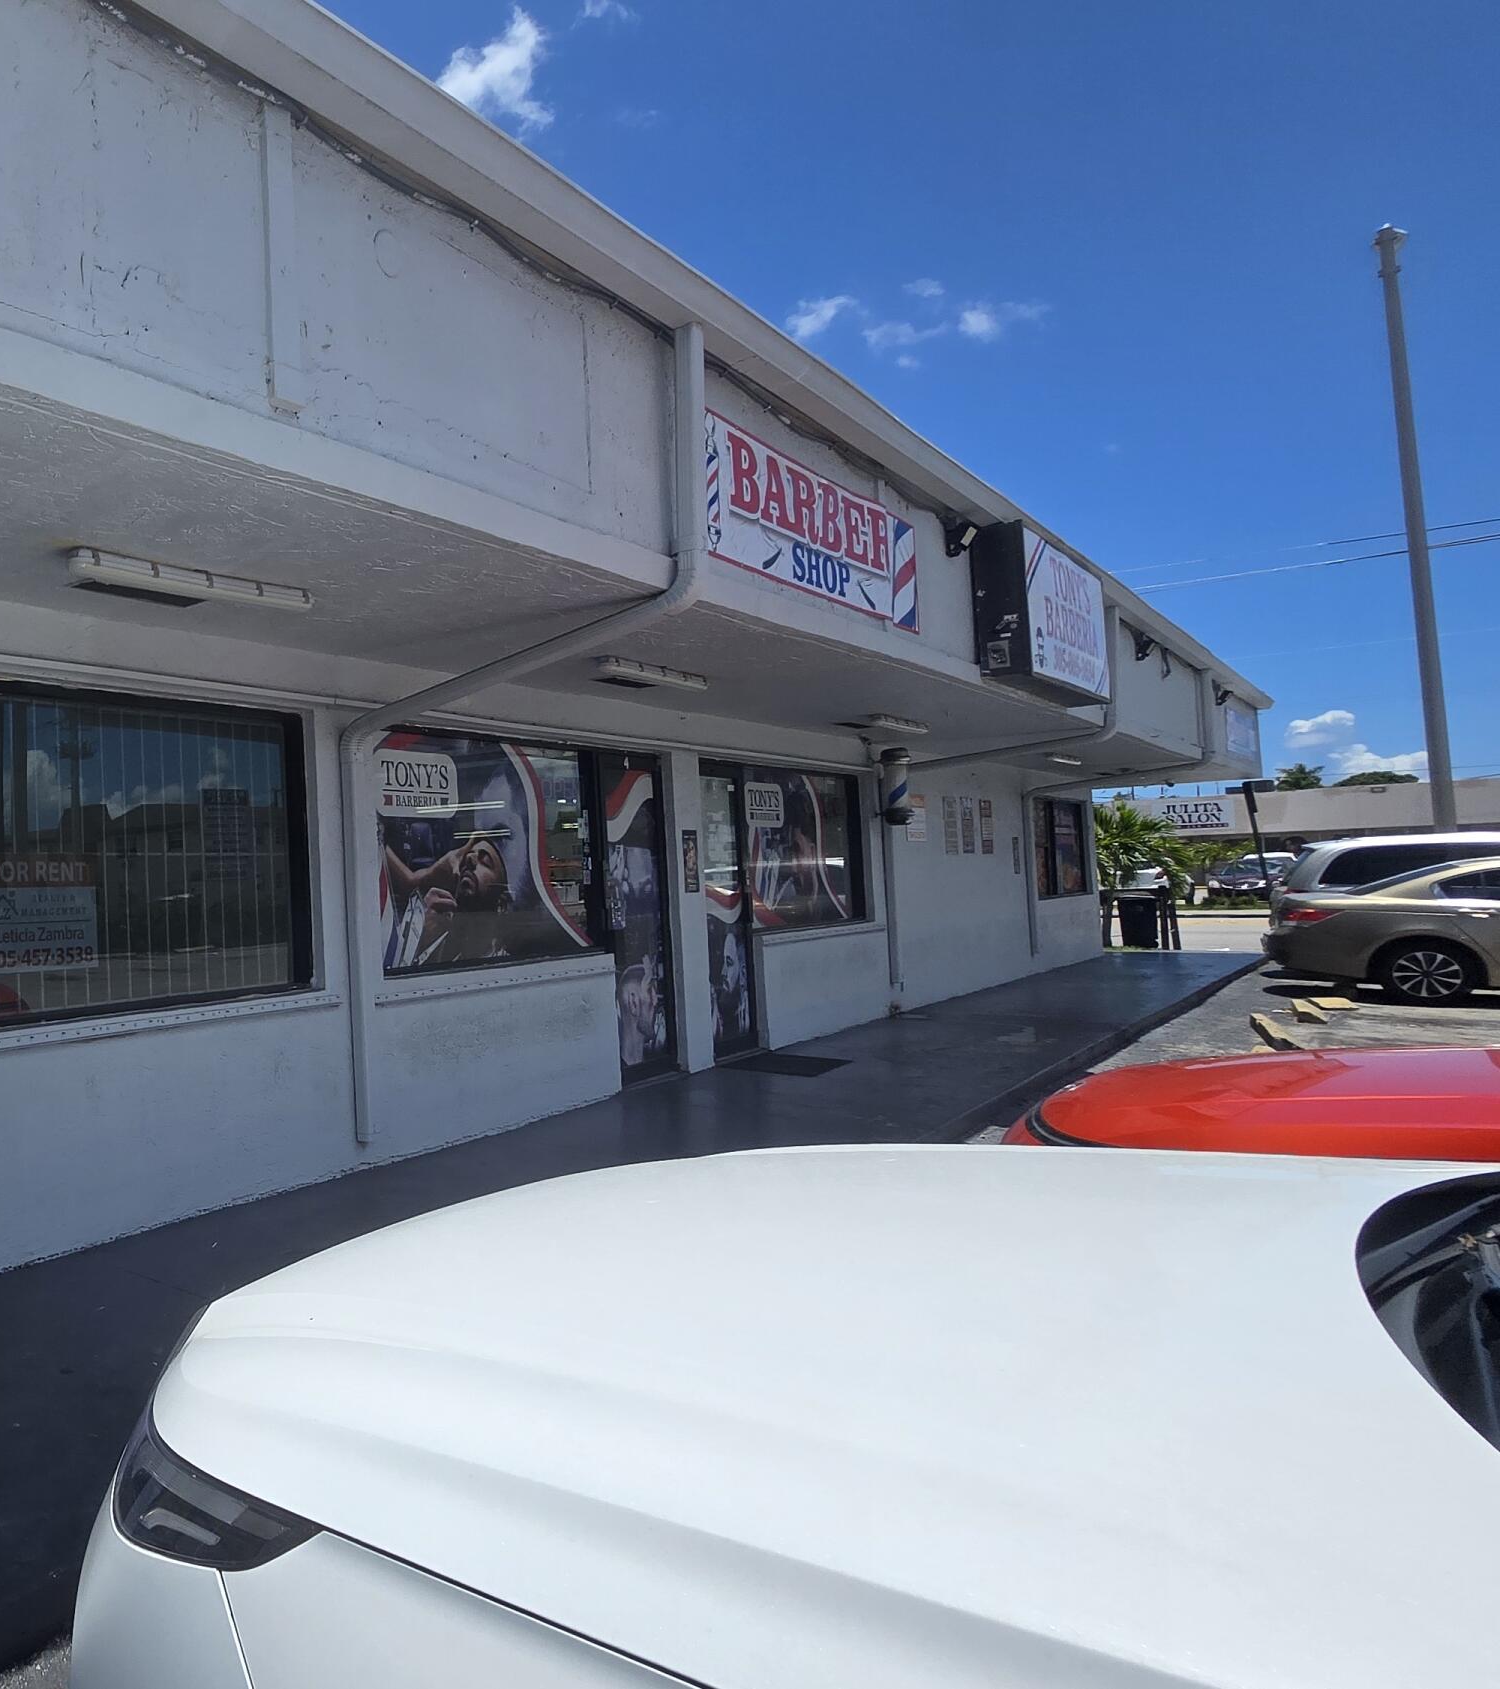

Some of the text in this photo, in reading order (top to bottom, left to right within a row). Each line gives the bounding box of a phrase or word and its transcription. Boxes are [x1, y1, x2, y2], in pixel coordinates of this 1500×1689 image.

[726, 430, 891, 576] BARBER
[792, 541, 851, 598] SHOP
[1049, 558, 1091, 616] TONY'S
[1044, 595, 1099, 660] BARBERIA
[380, 760, 449, 790] TONY'S
[395, 794, 438, 808] BARBERIA
[1161, 802, 1224, 815] JULITA
[1165, 812, 1221, 824] SALON
[35, 861, 86, 882] RENT
[37, 926, 85, 942] Zambra
